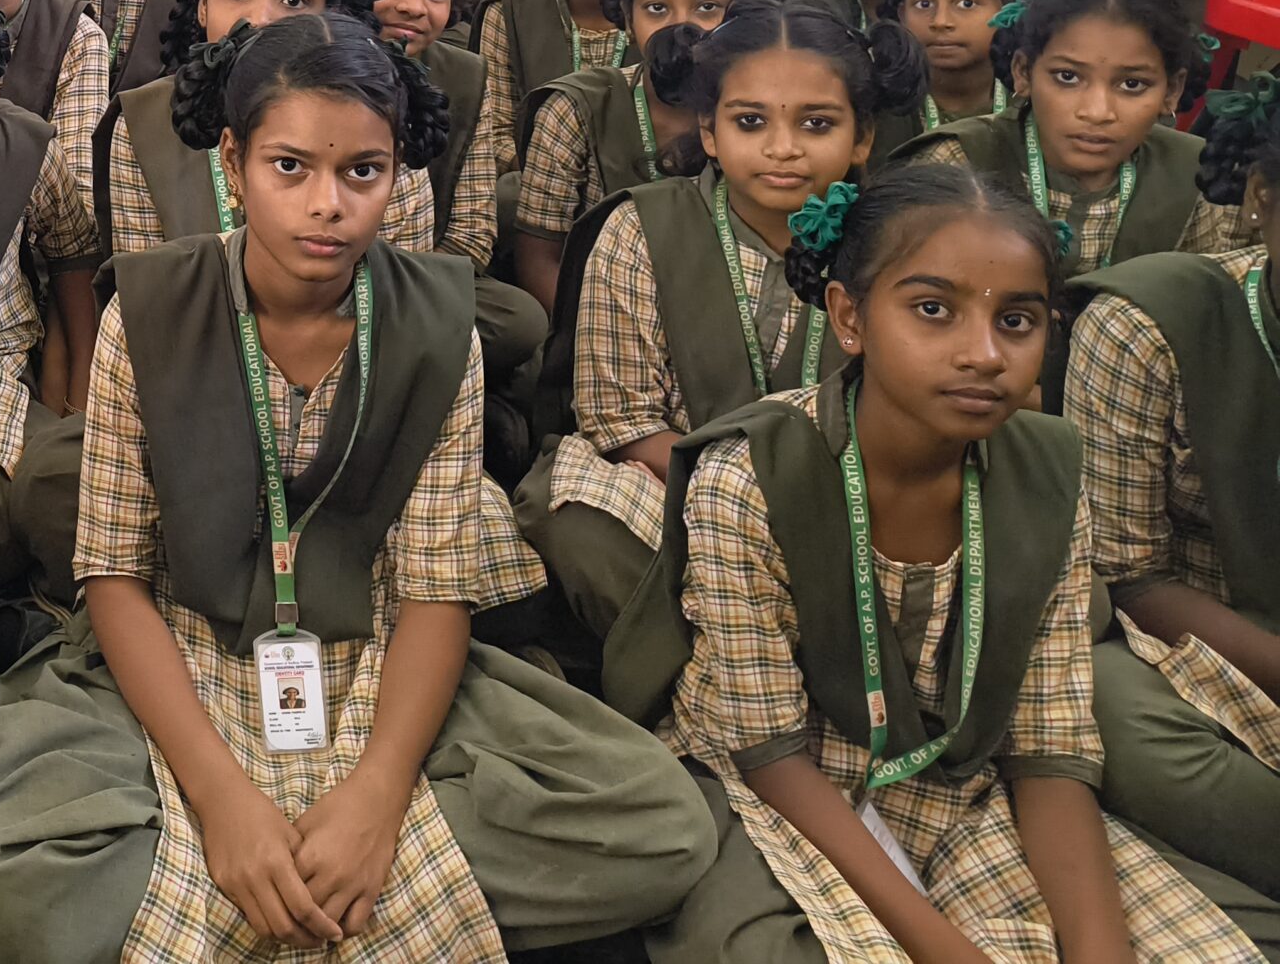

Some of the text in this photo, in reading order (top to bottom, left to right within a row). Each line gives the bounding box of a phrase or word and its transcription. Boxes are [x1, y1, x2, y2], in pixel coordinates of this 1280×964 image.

[216, 173, 230, 212] SCHOOL
[719, 223, 745, 296] EDUCATIONAL
[738, 298, 755, 343] SCHOOL
[243, 318, 265, 402] EDUCATIONAL
[806, 331, 821, 374] SCHOOL
[257, 404, 273, 450] SCHOOL
[265, 452, 279, 472] A.P.
[268, 474, 279, 489] OF
[271, 492, 284, 528] GOVT.
[968, 482, 982, 576] DEPARTMENT
[856, 527, 870, 584] SCHOOL
[861, 587, 873, 612] A.P.
[863, 614, 875, 633] OF
[965, 579, 982, 677] EDUCATIONAL
[867, 636, 880, 676] GOVT.
[874, 756, 911, 778] GOVT.
[910, 748, 928, 764] OF
